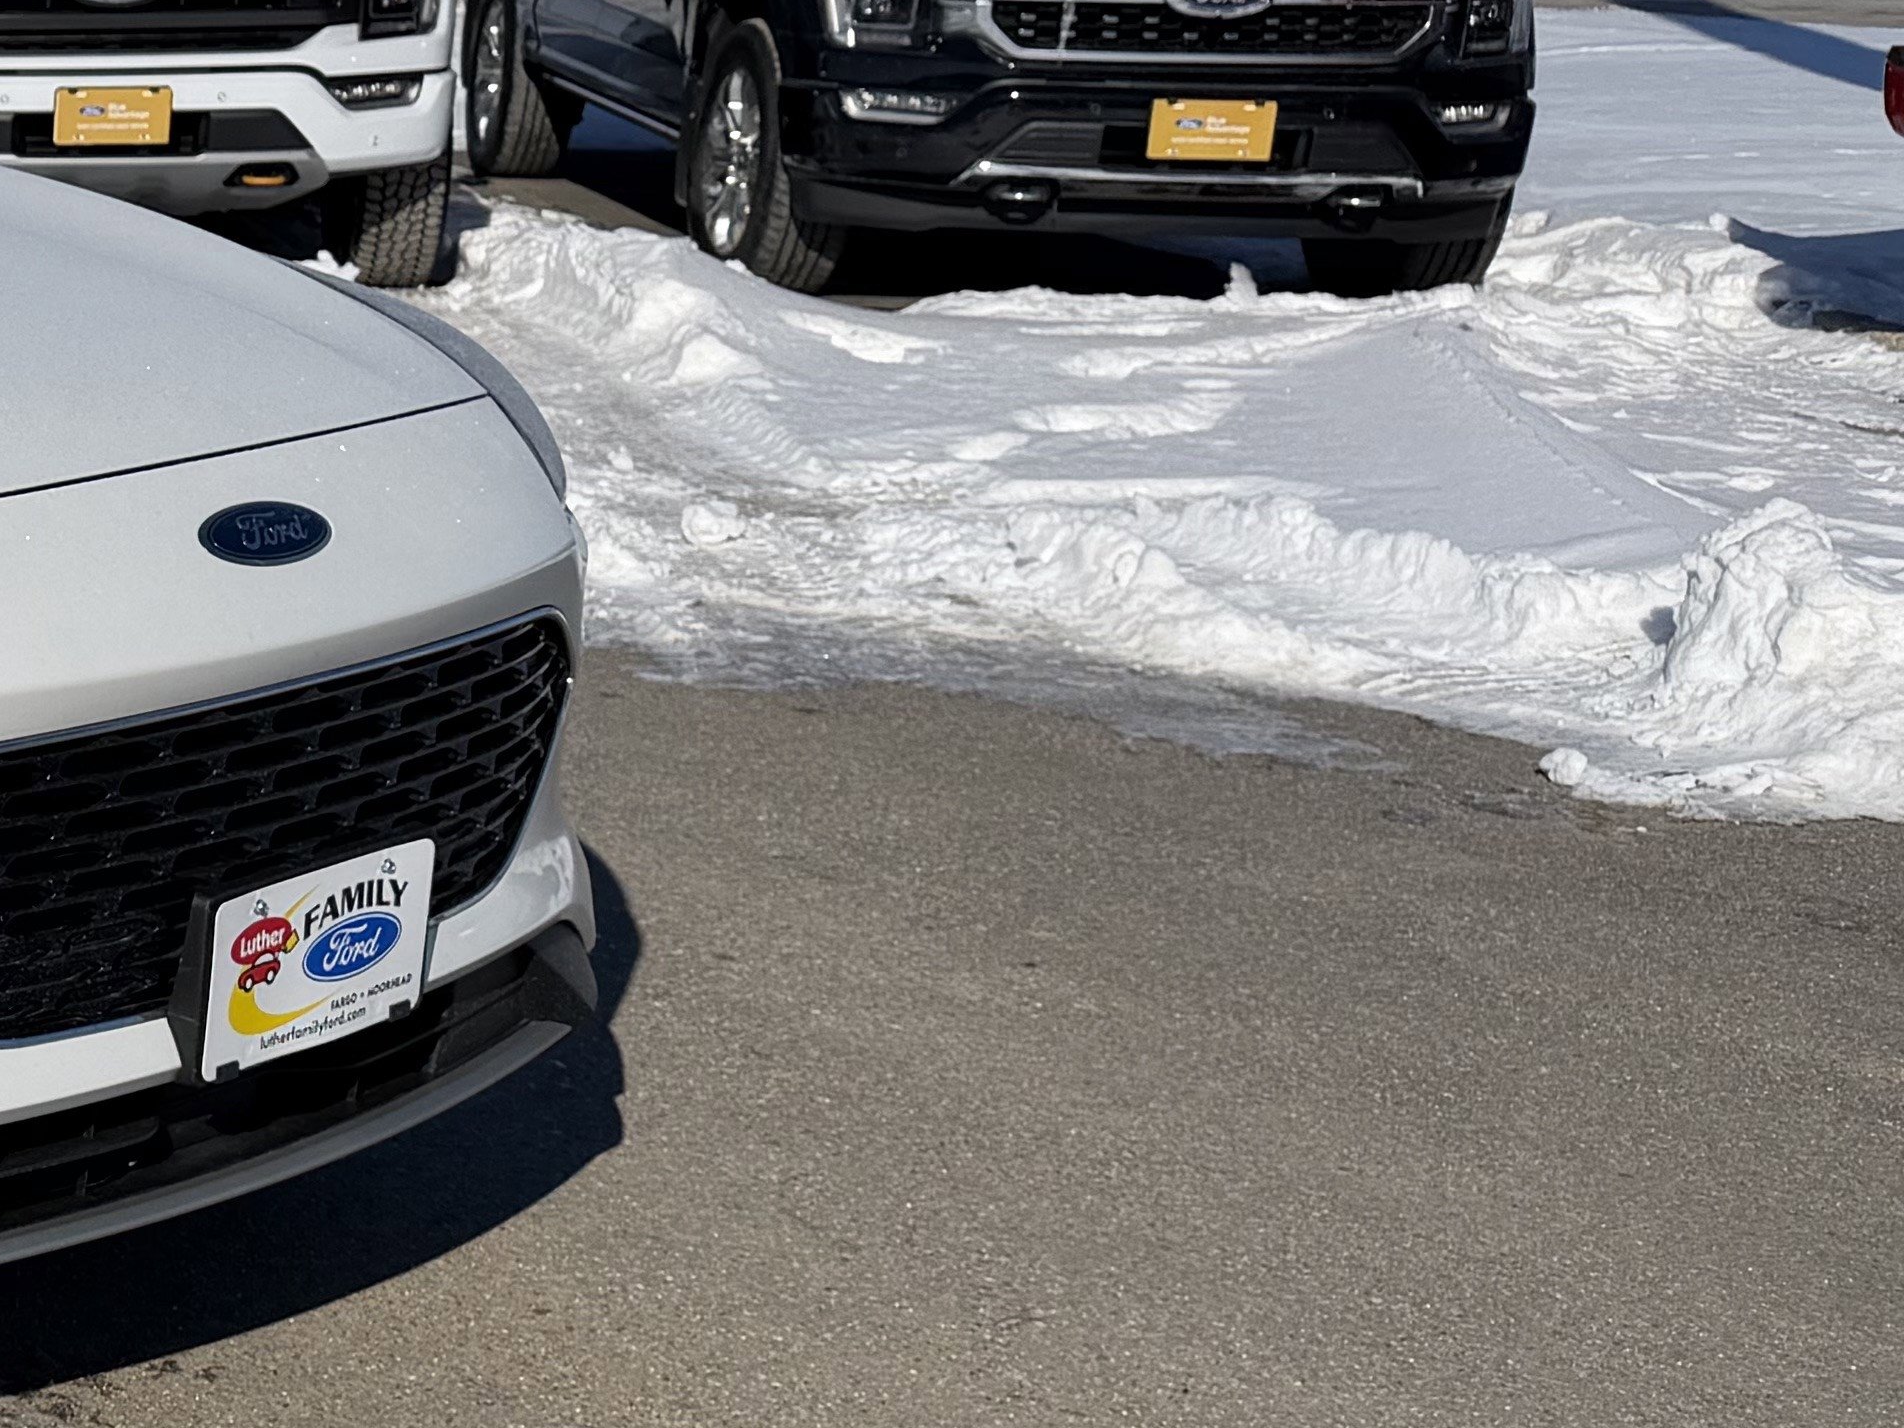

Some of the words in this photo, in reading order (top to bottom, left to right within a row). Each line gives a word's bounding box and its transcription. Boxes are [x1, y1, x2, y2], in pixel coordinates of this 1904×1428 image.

[236, 510, 309, 551] Ford
[303, 878, 409, 941] FAMILY
[239, 927, 286, 958] Luther
[322, 923, 383, 972] Ford
[330, 992, 358, 1012] FARGO
[366, 972, 413, 998] MOORHEAD
[259, 1006, 367, 1050] lutherfamilyford.com
